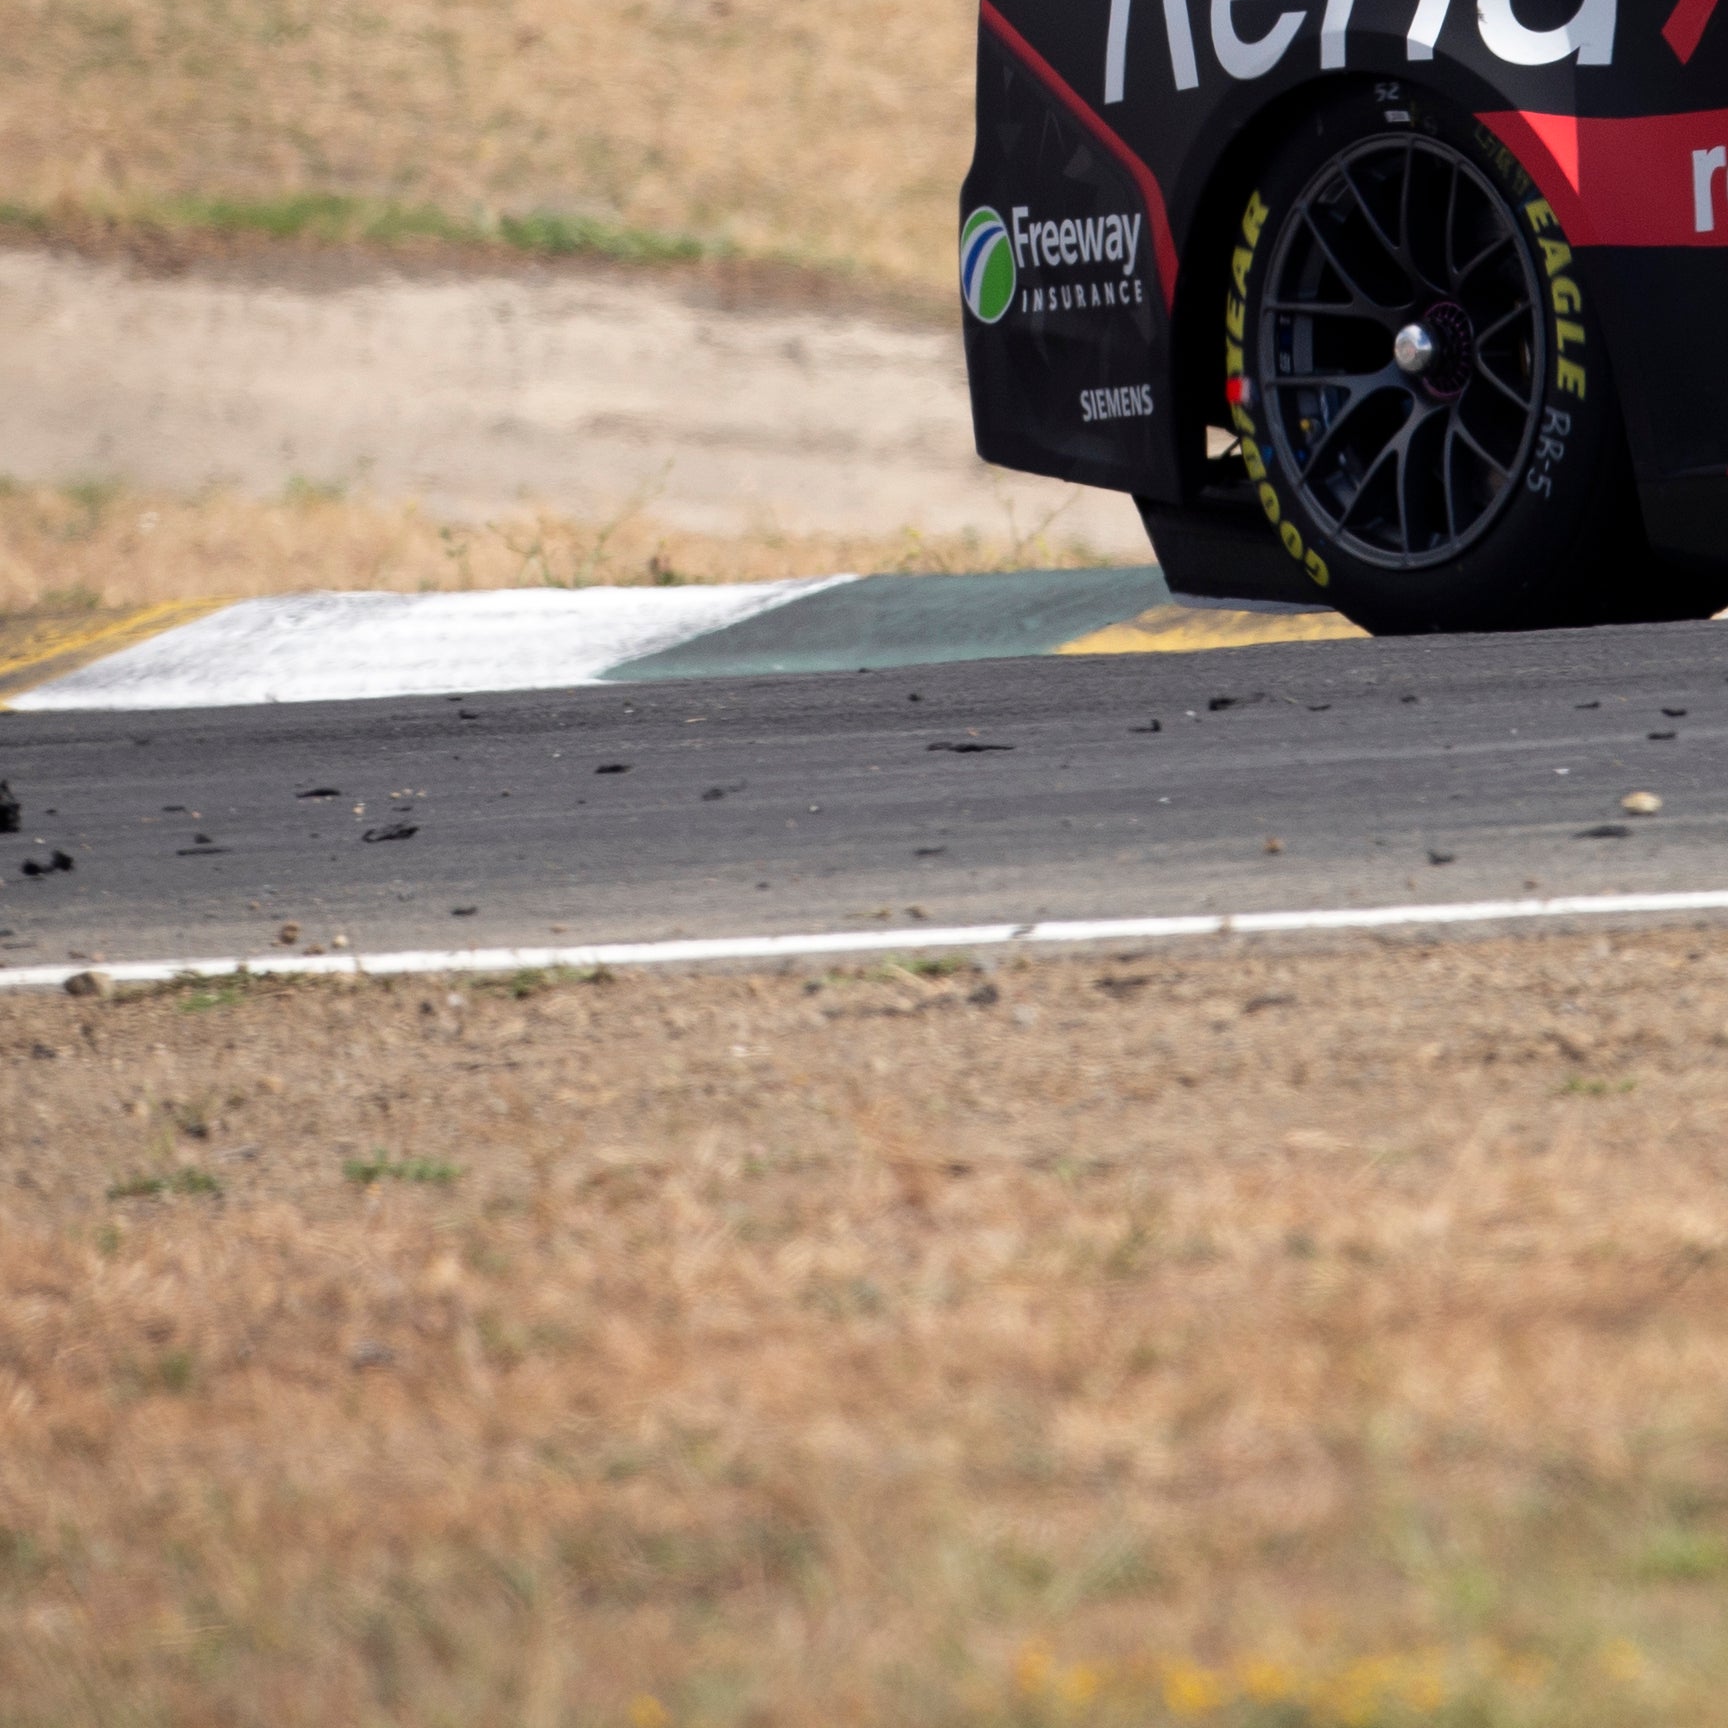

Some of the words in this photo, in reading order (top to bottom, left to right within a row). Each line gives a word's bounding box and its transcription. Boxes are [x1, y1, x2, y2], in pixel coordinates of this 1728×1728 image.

[1012, 205, 1142, 276] Freeway
[1022, 279, 1144, 313] INSURANCE
[1524, 197, 1588, 400] EAGLE
[1080, 383, 1155, 422] SIEMENS
